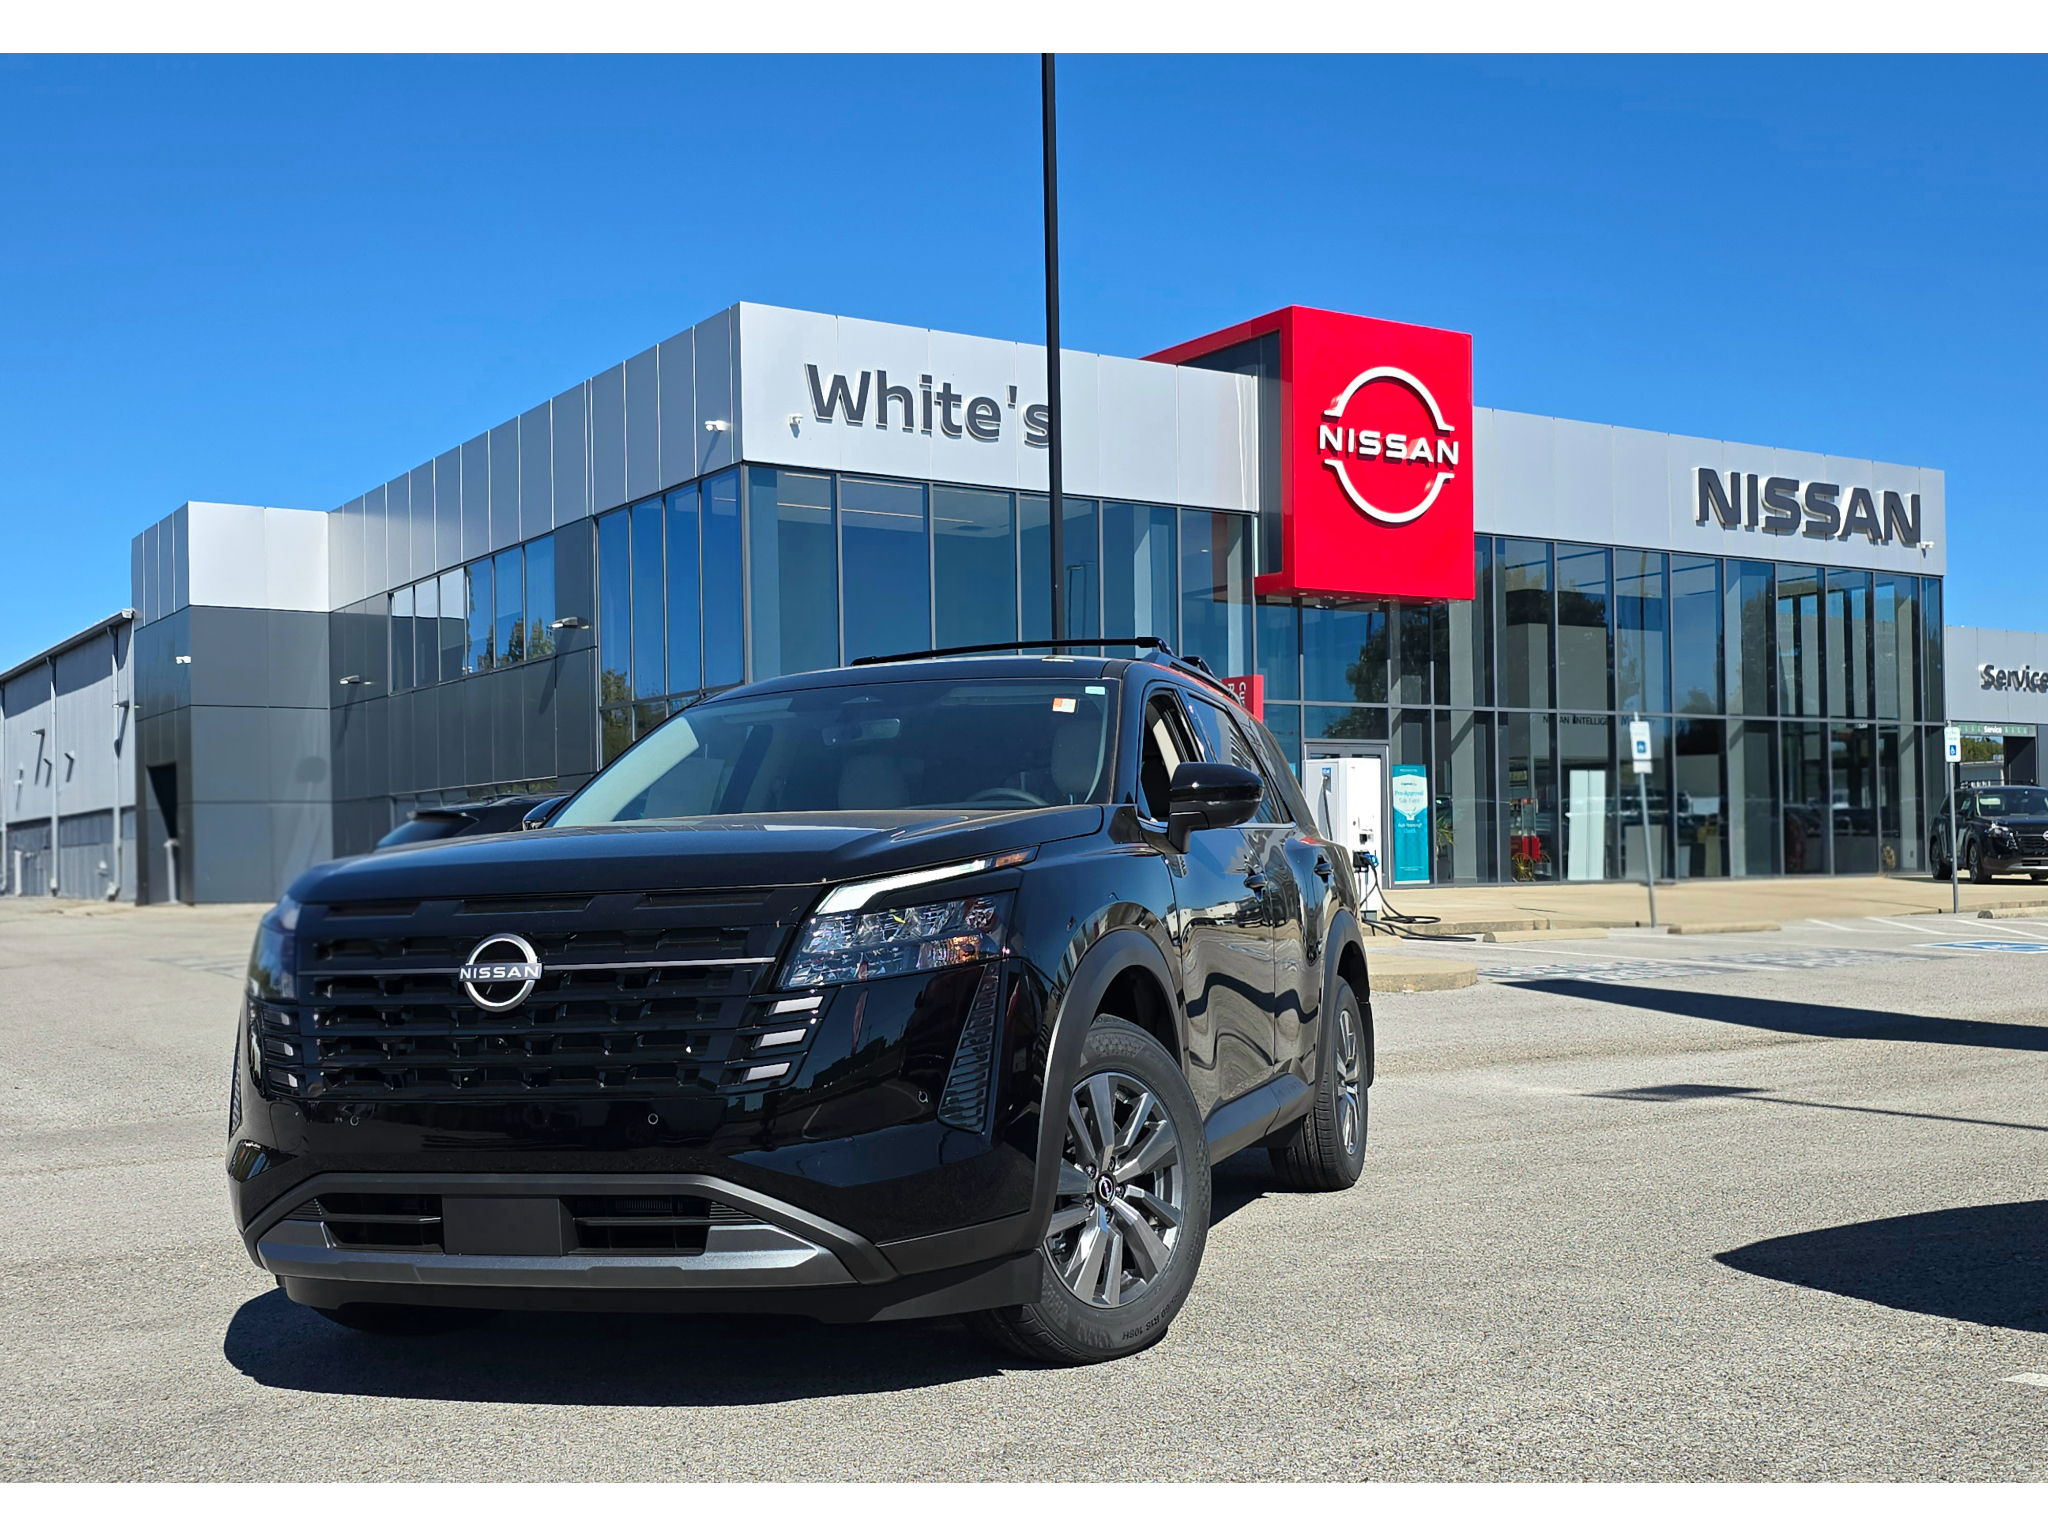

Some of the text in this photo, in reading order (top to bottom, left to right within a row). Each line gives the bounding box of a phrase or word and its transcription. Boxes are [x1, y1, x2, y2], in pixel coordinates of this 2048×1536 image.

[804, 363, 1048, 447] White's
[1318, 424, 1459, 466] NISSAN
[1695, 466, 1921, 545] NISSAN
[1980, 664, 2048, 692] Service
[460, 966, 539, 980] NISSAN
